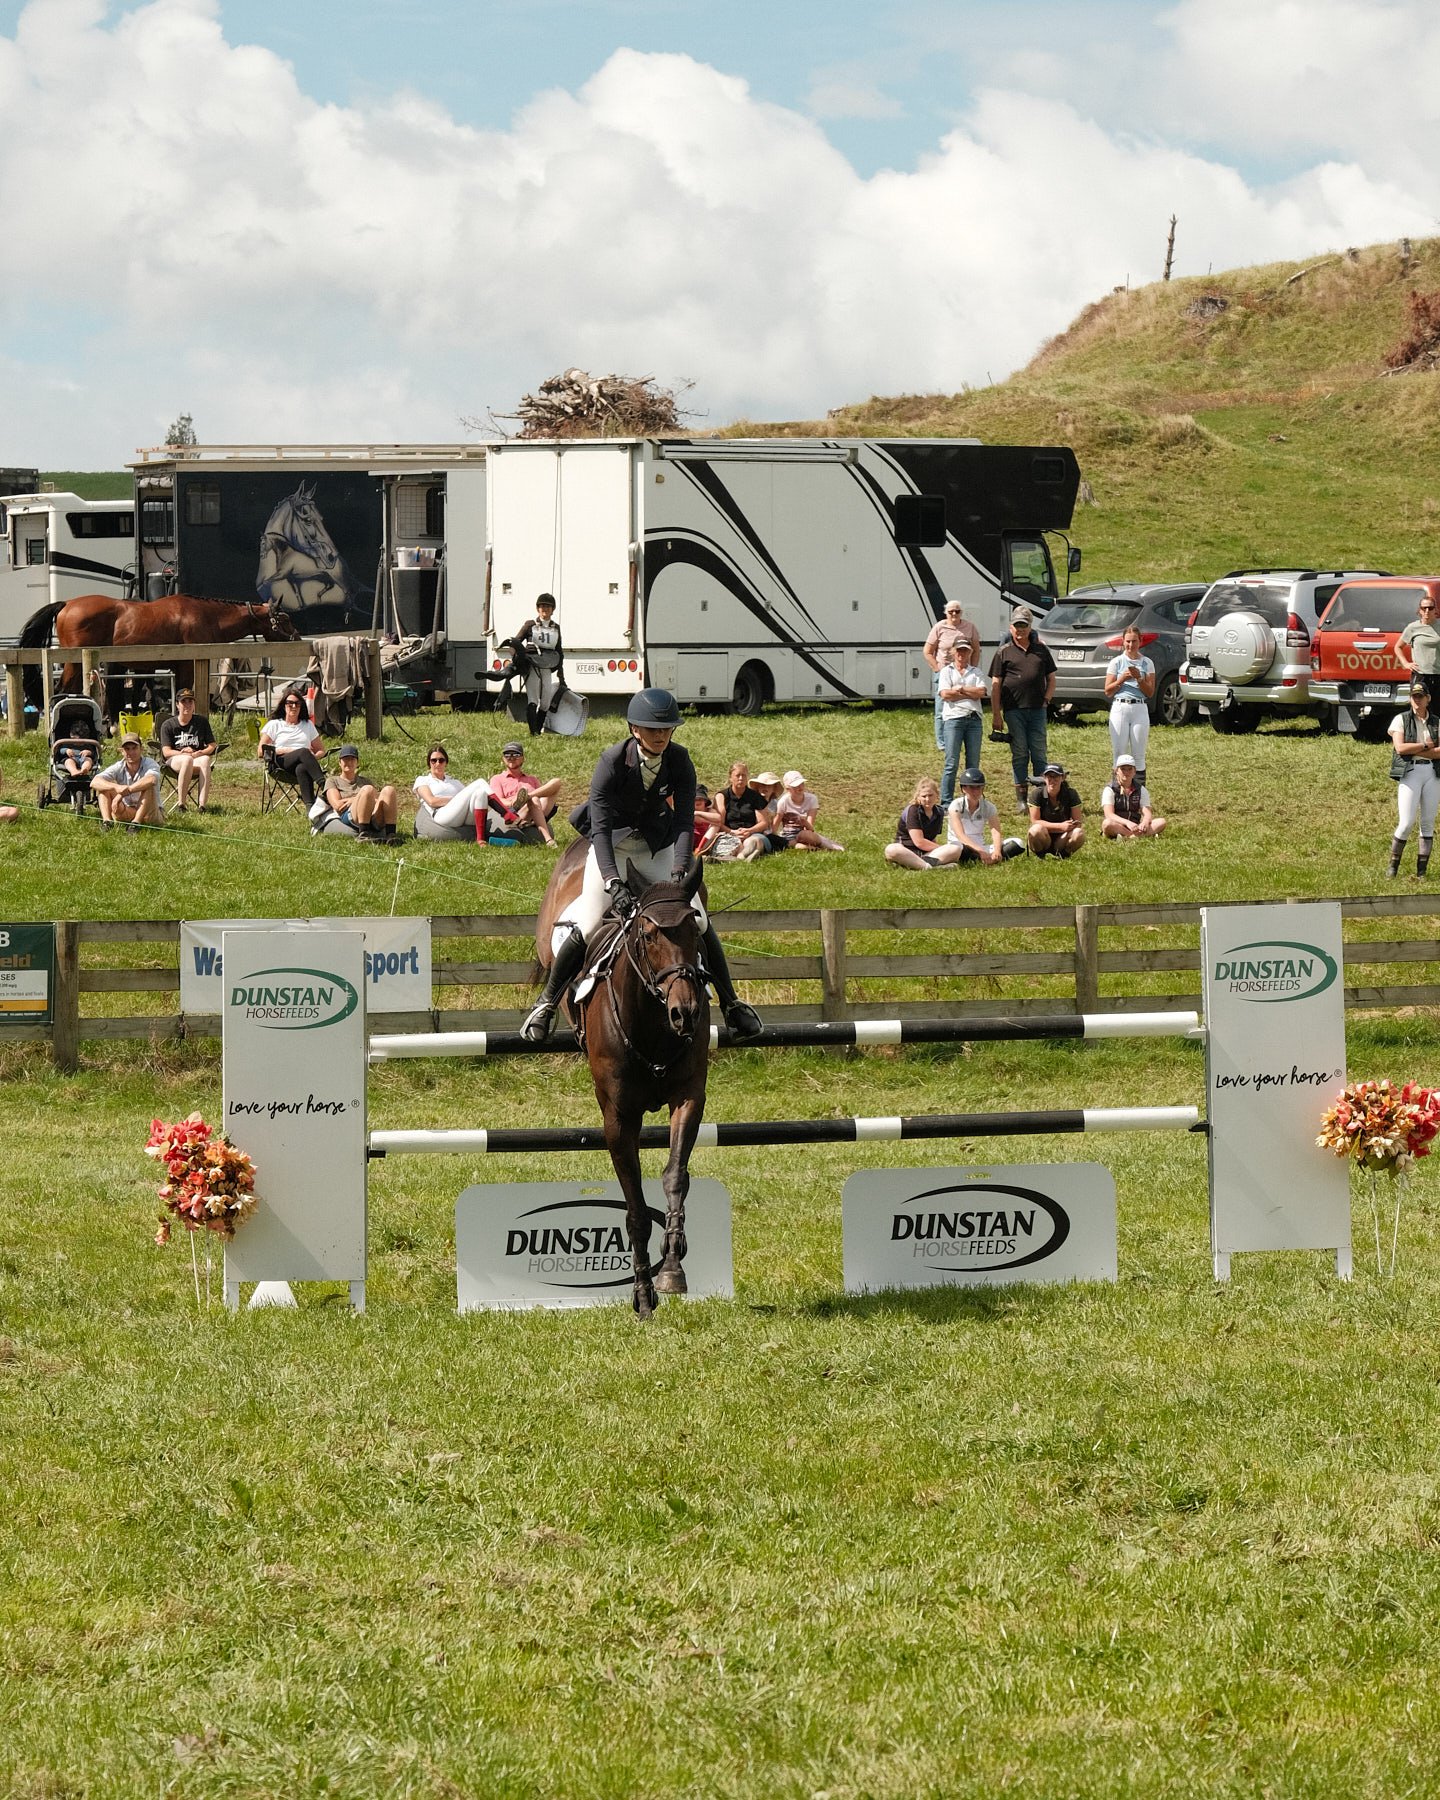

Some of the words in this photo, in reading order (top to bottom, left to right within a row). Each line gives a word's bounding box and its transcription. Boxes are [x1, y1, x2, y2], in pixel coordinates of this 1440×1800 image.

[1336, 653, 1406, 670] TOYOTA
[1214, 959, 1314, 981] DUNSTAN
[1229, 979, 1301, 993] HORSEFEEDS
[230, 987, 334, 1006] DUNSTAN
[246, 1007, 320, 1019] HORSEFEEDS
[1216, 1074, 1251, 1089] Love
[1253, 1073, 1288, 1091] your
[1290, 1065, 1333, 1085] horse
[229, 1101, 265, 1116] Love
[267, 1101, 303, 1119] your
[306, 1094, 346, 1116] horse
[890, 1210, 1036, 1241] DUNSTAN
[912, 1239, 1017, 1258] HORSEFEEDS
[527, 1255, 632, 1274] HORSEFEEDS
